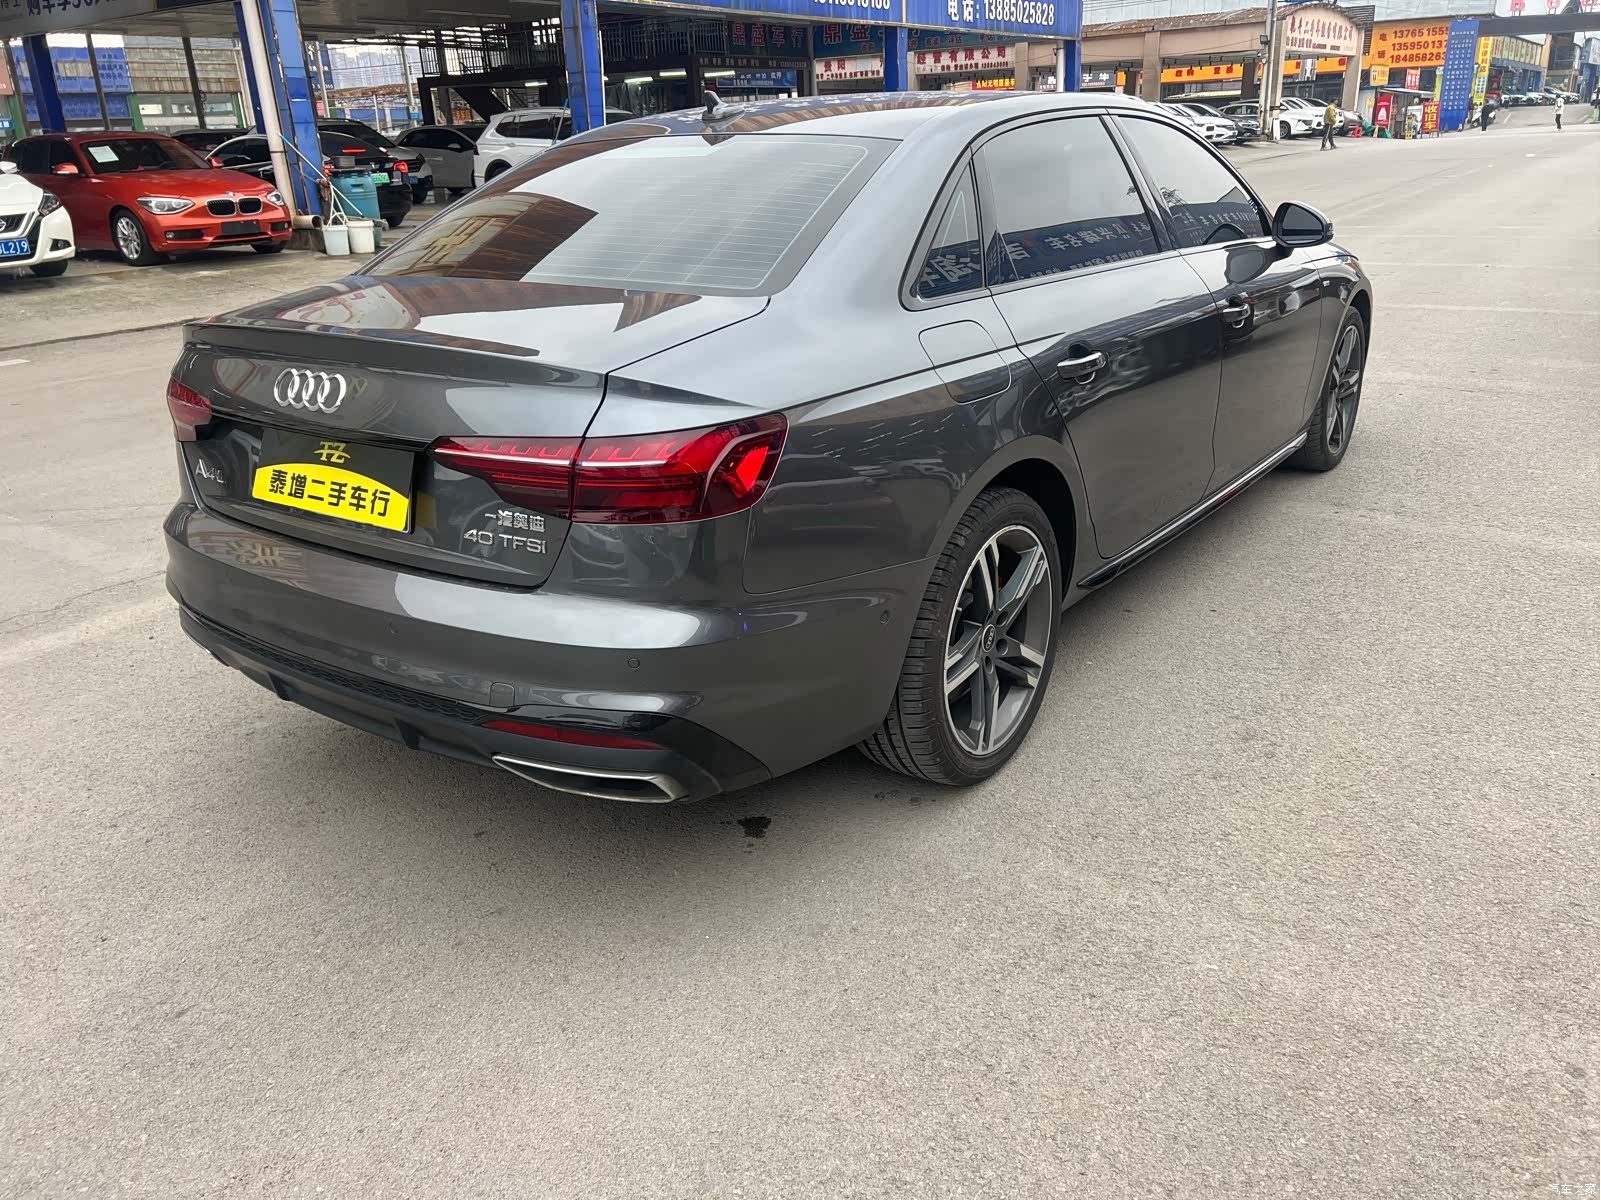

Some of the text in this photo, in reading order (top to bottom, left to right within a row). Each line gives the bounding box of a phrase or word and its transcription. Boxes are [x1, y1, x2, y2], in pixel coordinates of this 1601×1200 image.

[916, 45, 1007, 65] 经营有限公司
[195, 458, 226, 484] A4L
[269, 469, 391, 517] 泰增二手车行
[484, 509, 546, 533] 一汽奥迪
[463, 528, 494, 546] 40
